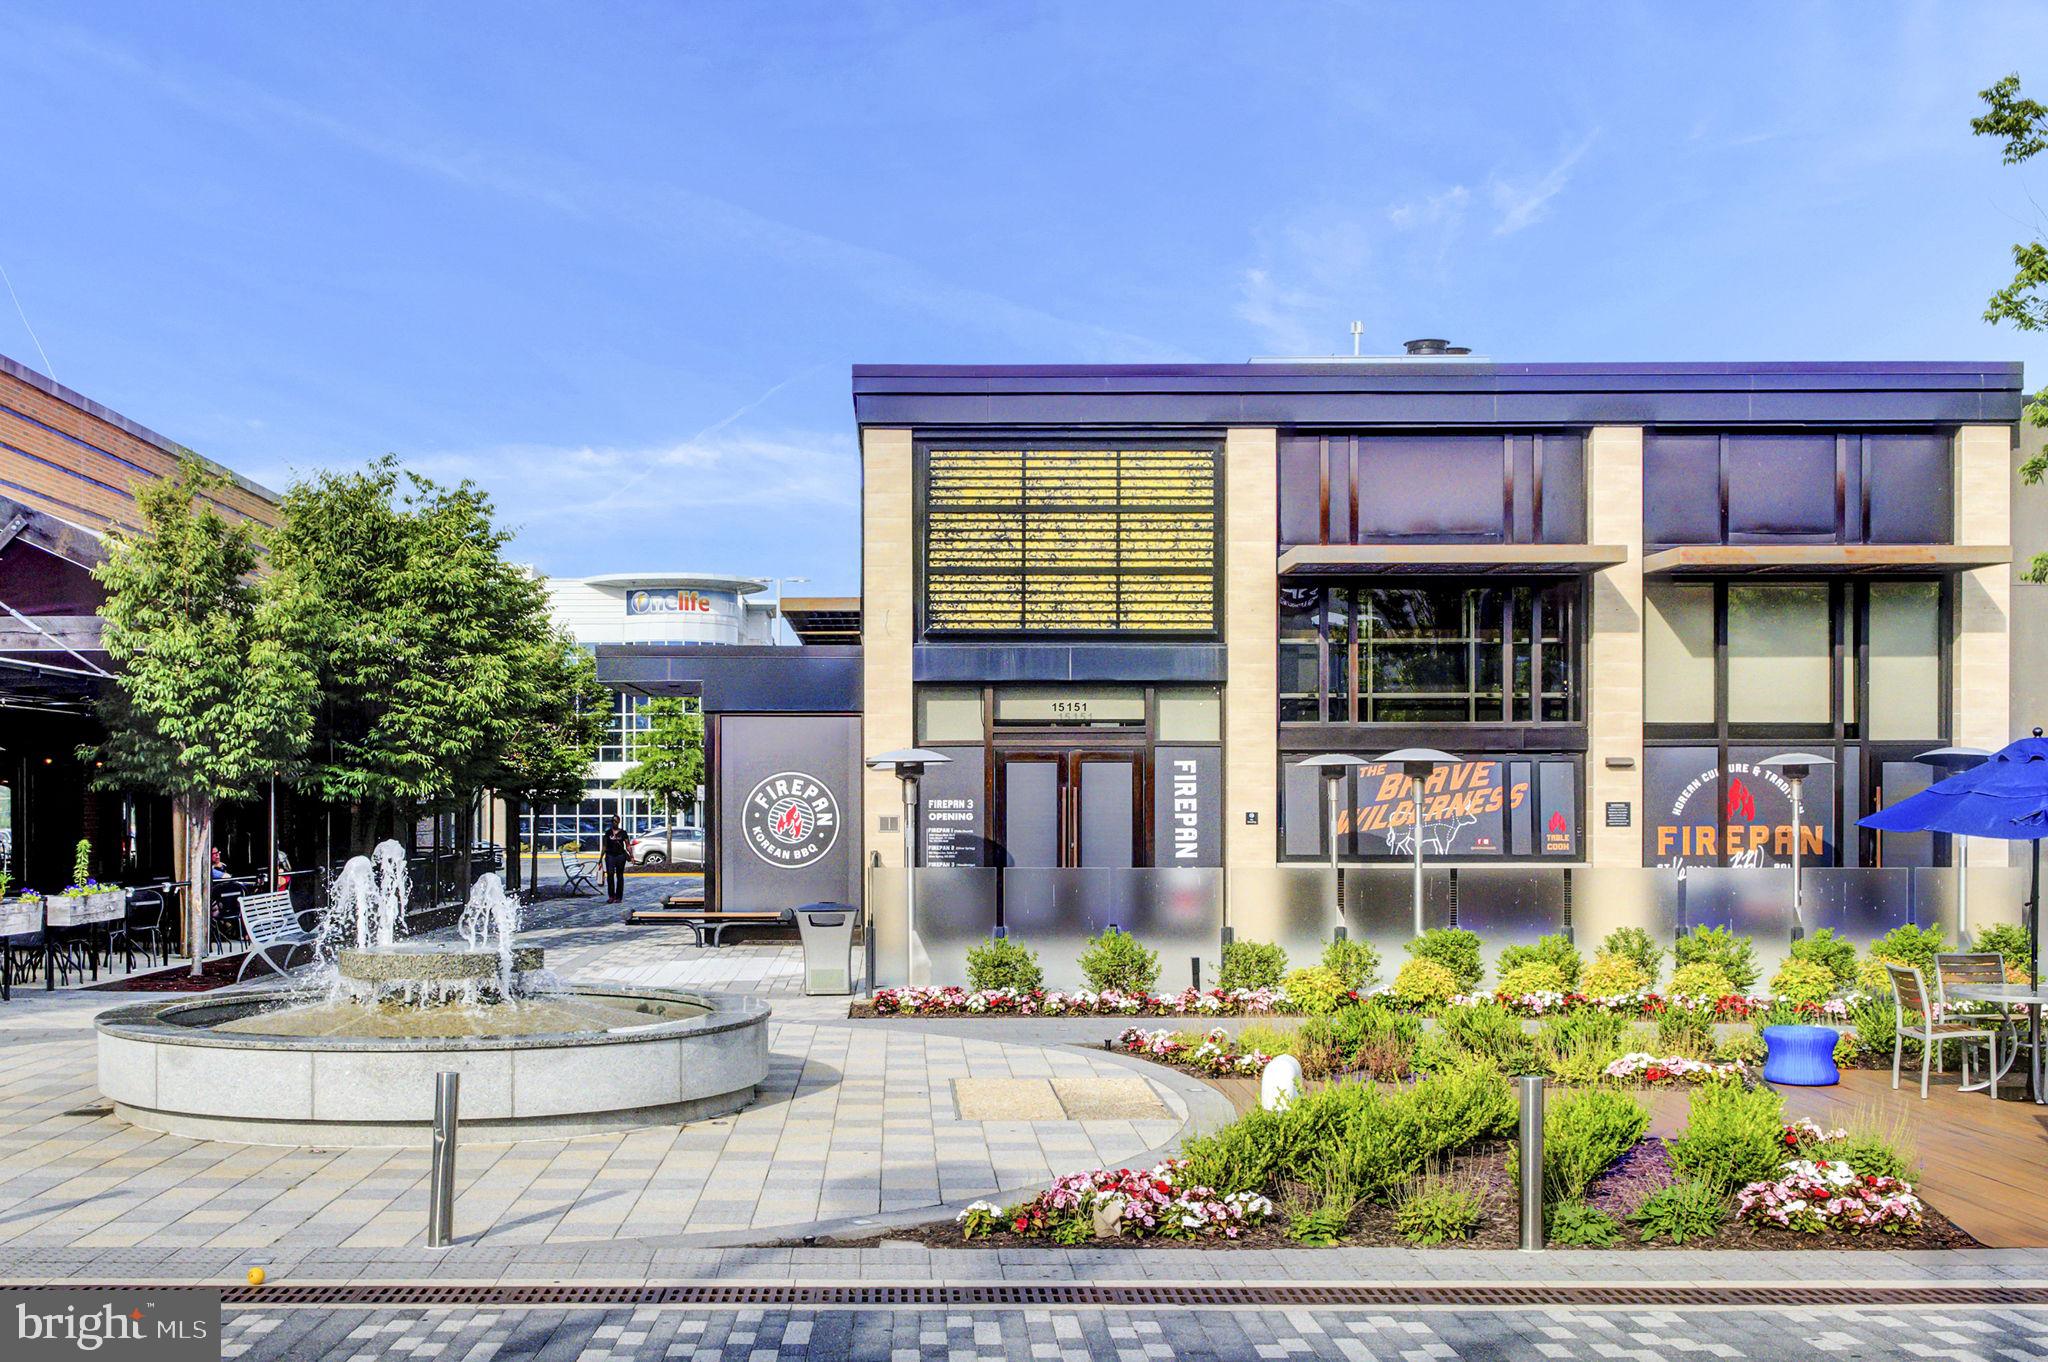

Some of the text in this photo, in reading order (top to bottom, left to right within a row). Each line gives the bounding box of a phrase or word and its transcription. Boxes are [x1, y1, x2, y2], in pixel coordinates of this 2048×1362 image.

[1052, 702, 1087, 712] 15151
[1359, 763, 1387, 778] THE
[754, 778, 833, 826] FIREPAN
[928, 799, 974, 809] FIREPAN 3
[1173, 760, 1198, 858] FIREPAN
[928, 812, 974, 821] OPENING
[752, 826, 818, 860] KOREAN BBQ
[1546, 834, 1569, 842] TABLE
[1657, 825, 1824, 856] FIREPAN
[1546, 843, 1569, 851] COOK
